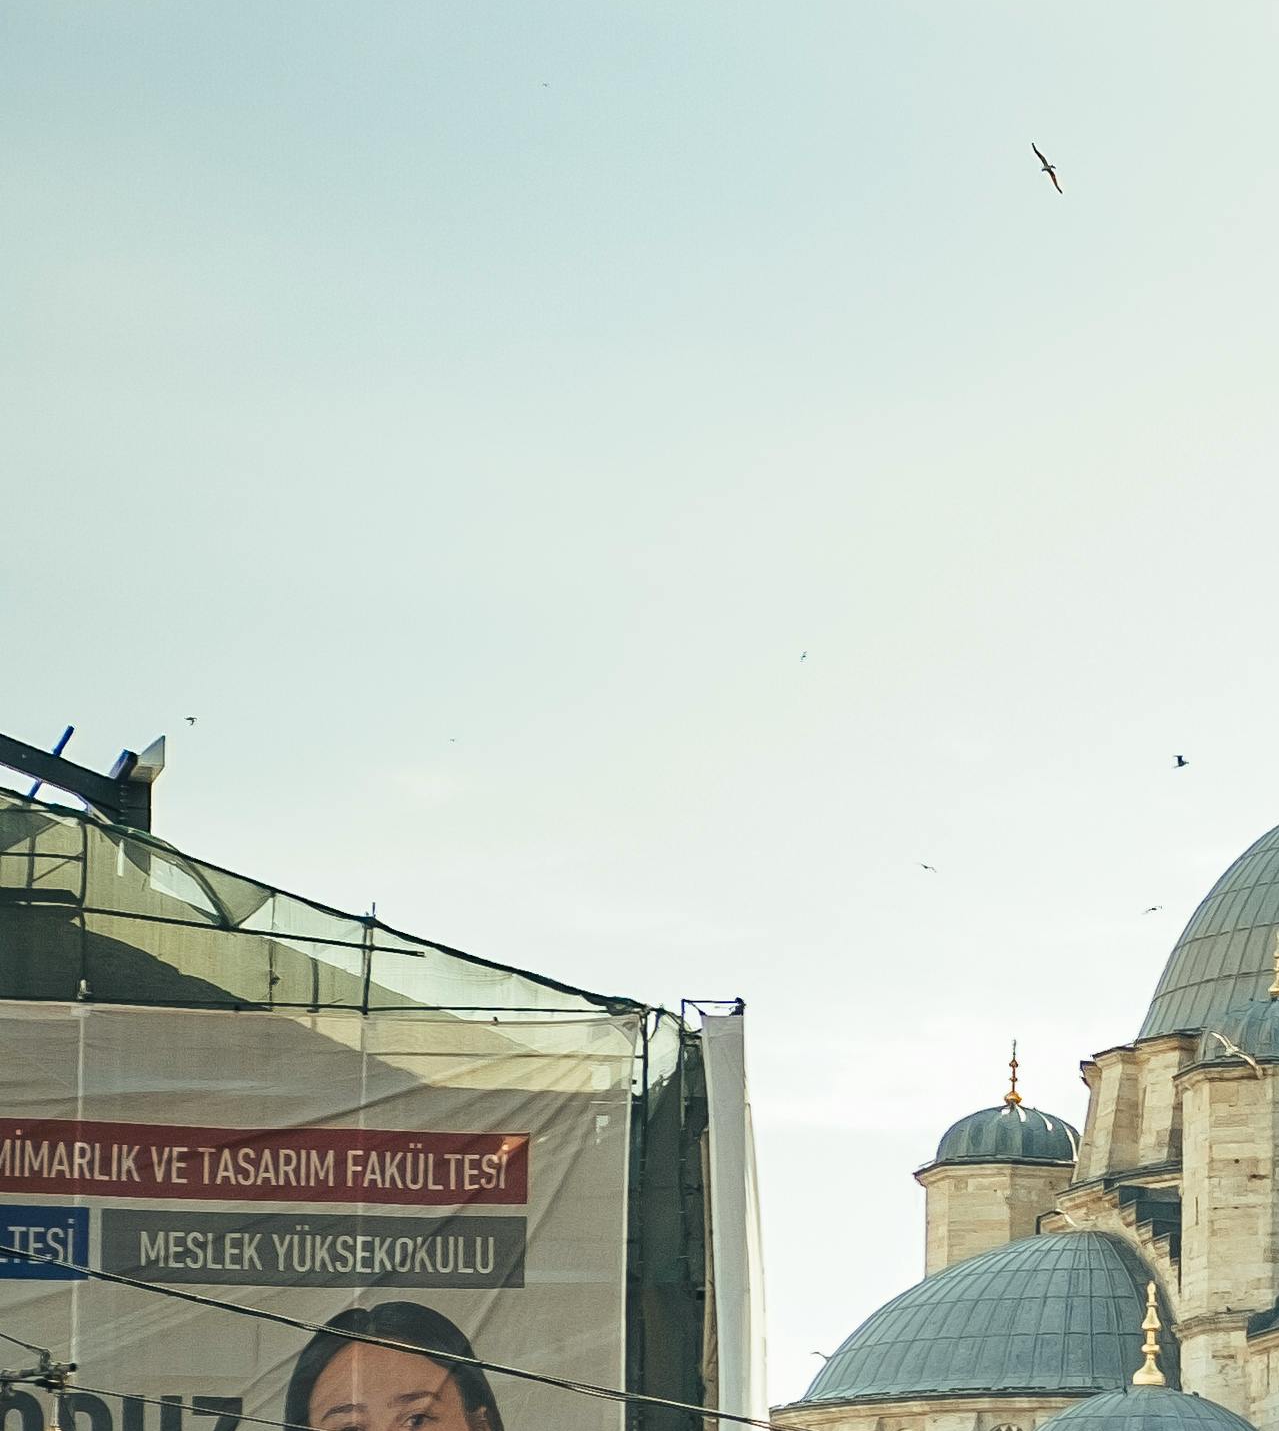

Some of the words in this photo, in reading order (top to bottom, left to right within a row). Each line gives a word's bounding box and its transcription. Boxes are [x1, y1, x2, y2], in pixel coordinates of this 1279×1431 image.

[151, 1146, 188, 1184] VE
[197, 1147, 334, 1187] TASARIM
[346, 1143, 508, 1191] FAKÜLTESİ
[139, 1231, 263, 1271] MESLEK
[272, 1225, 495, 1274] YÜKSEKOKULU
